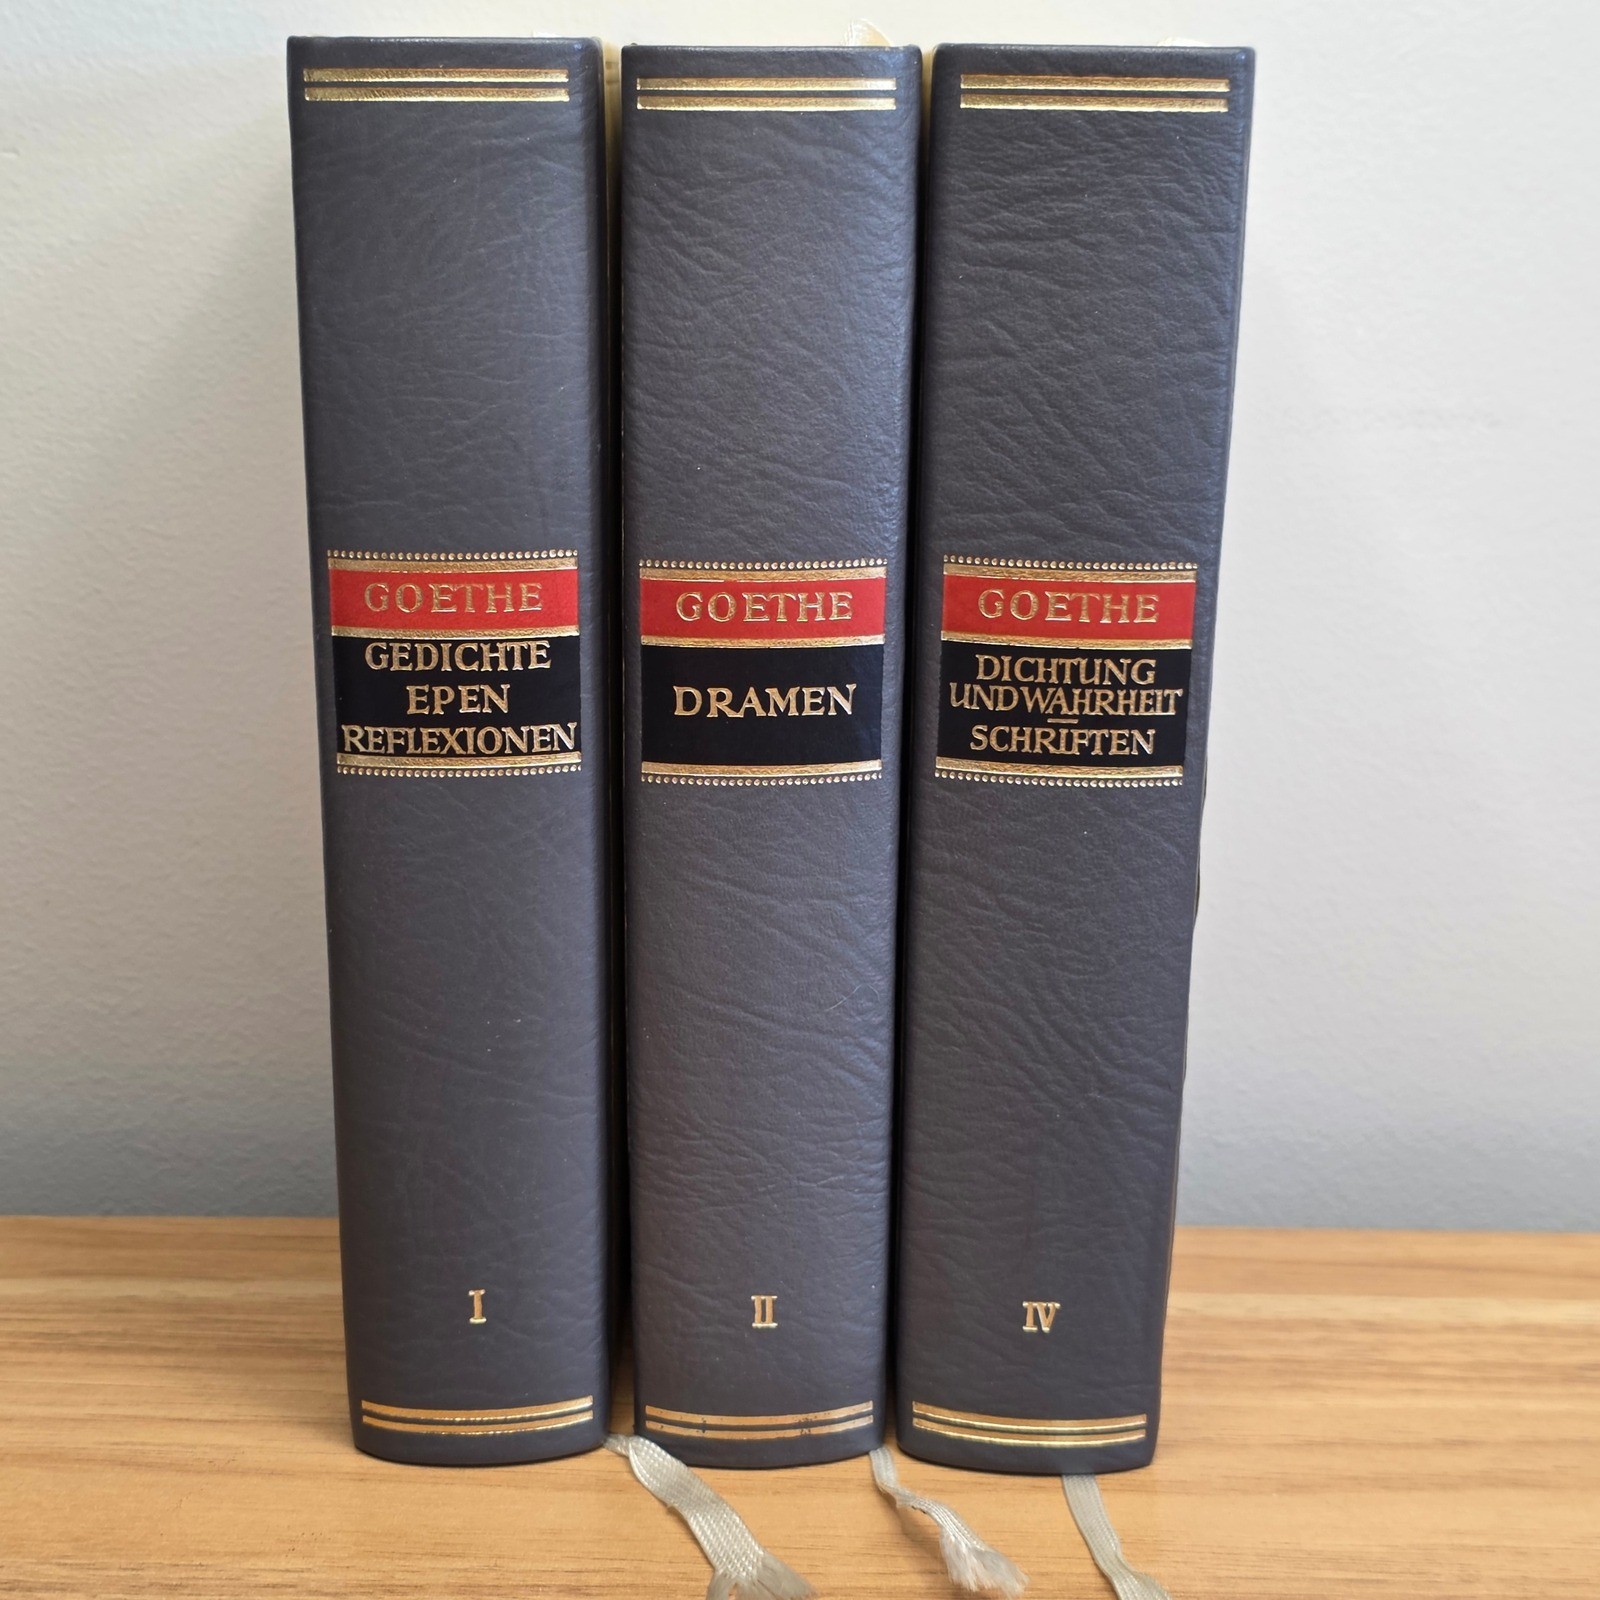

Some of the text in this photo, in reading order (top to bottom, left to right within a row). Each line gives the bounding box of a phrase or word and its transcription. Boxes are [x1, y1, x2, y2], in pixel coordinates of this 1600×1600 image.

[364, 582, 543, 613] GOETHE
[676, 591, 854, 623] GOETHE
[977, 589, 1160, 624] GOETHE
[364, 639, 552, 672] GEDICHTE
[975, 653, 1157, 686] DICHTUNG
[406, 683, 511, 715] EPEN
[672, 683, 857, 718] DRAMEN
[949, 682, 1184, 717] UND WAHRHEIT
[340, 721, 578, 756] REFLEXIONEN
[969, 724, 1156, 756] SCHRIFTEN
[468, 1289, 487, 1324] I
[750, 1294, 779, 1329] II
[1022, 1301, 1061, 1334] IV
